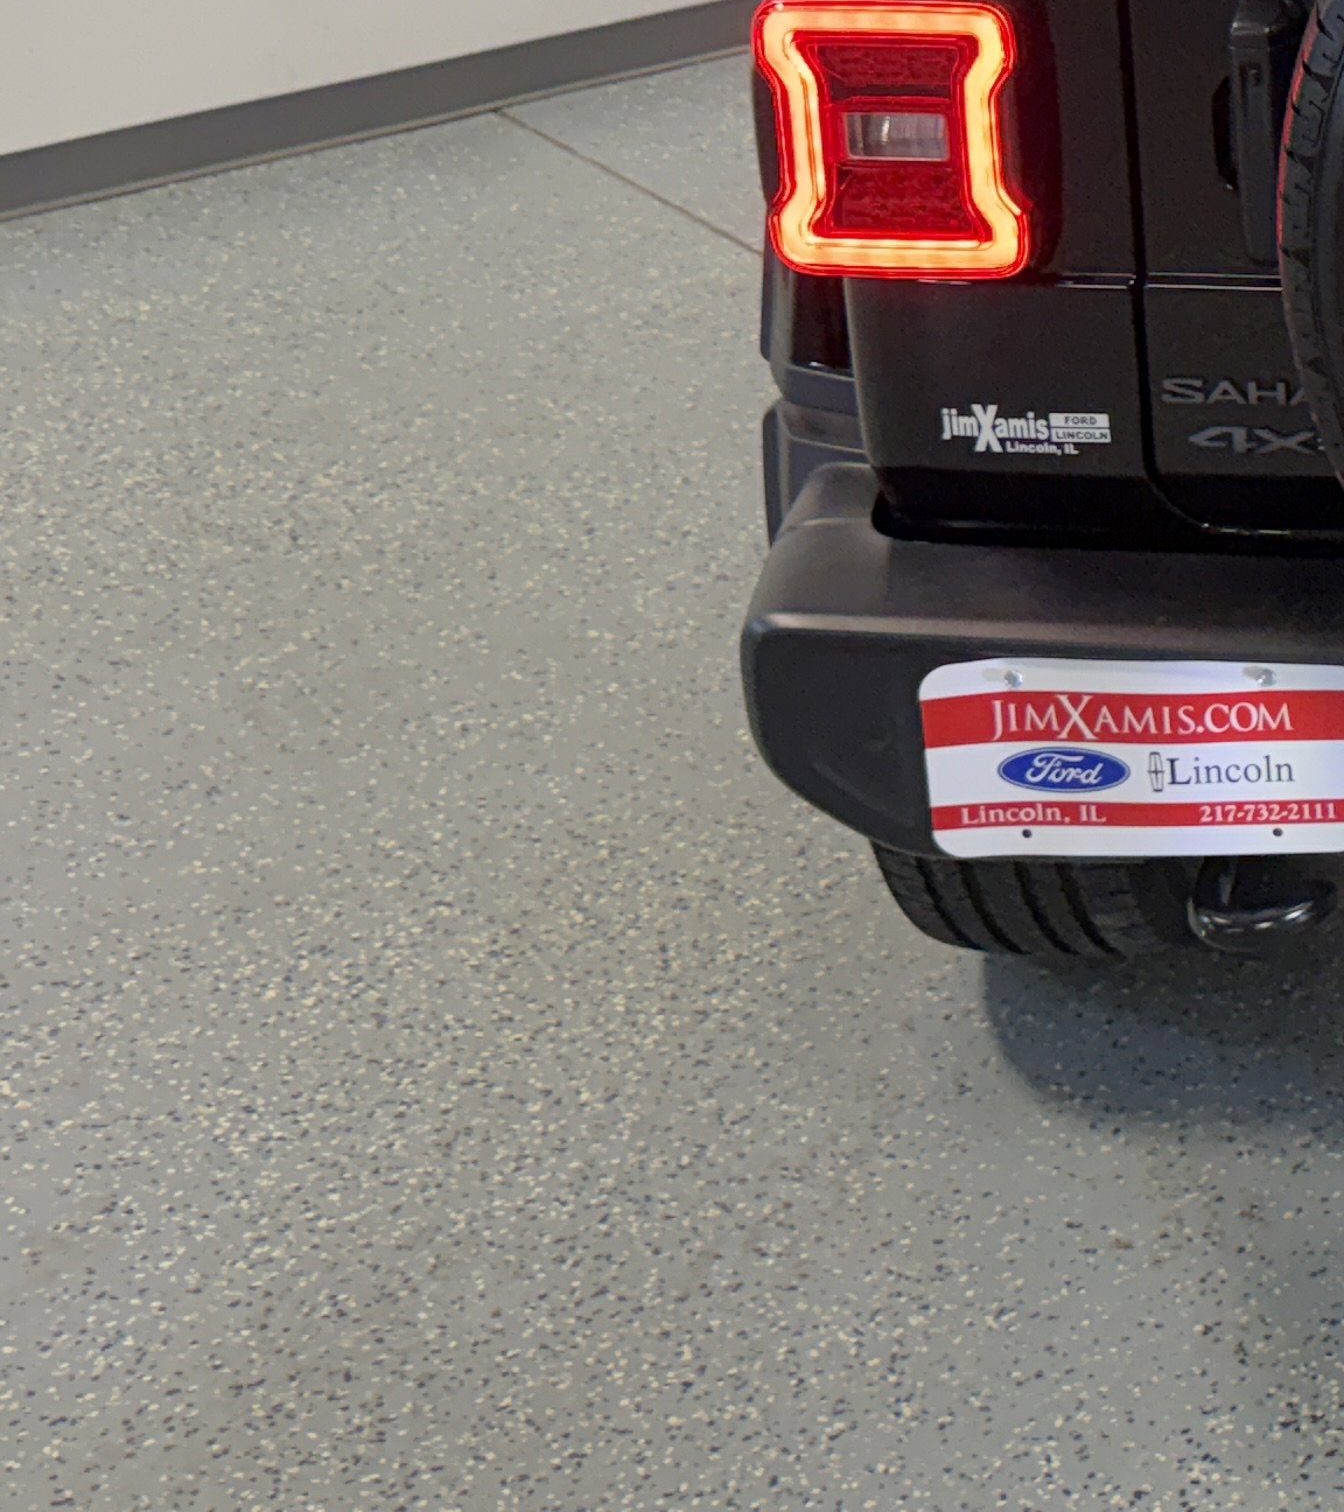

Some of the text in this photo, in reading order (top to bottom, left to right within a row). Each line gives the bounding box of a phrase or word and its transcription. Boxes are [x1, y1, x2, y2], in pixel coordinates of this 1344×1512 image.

[1064, 415, 1097, 425] FORD
[1055, 431, 1108, 440] LINCOLN
[1006, 441, 1079, 456] Lincoln, IL
[1024, 754, 1295, 786] Ford Lincoln
[1079, 804, 1106, 823] IL
[1200, 802, 1336, 823] 217-732-2111
